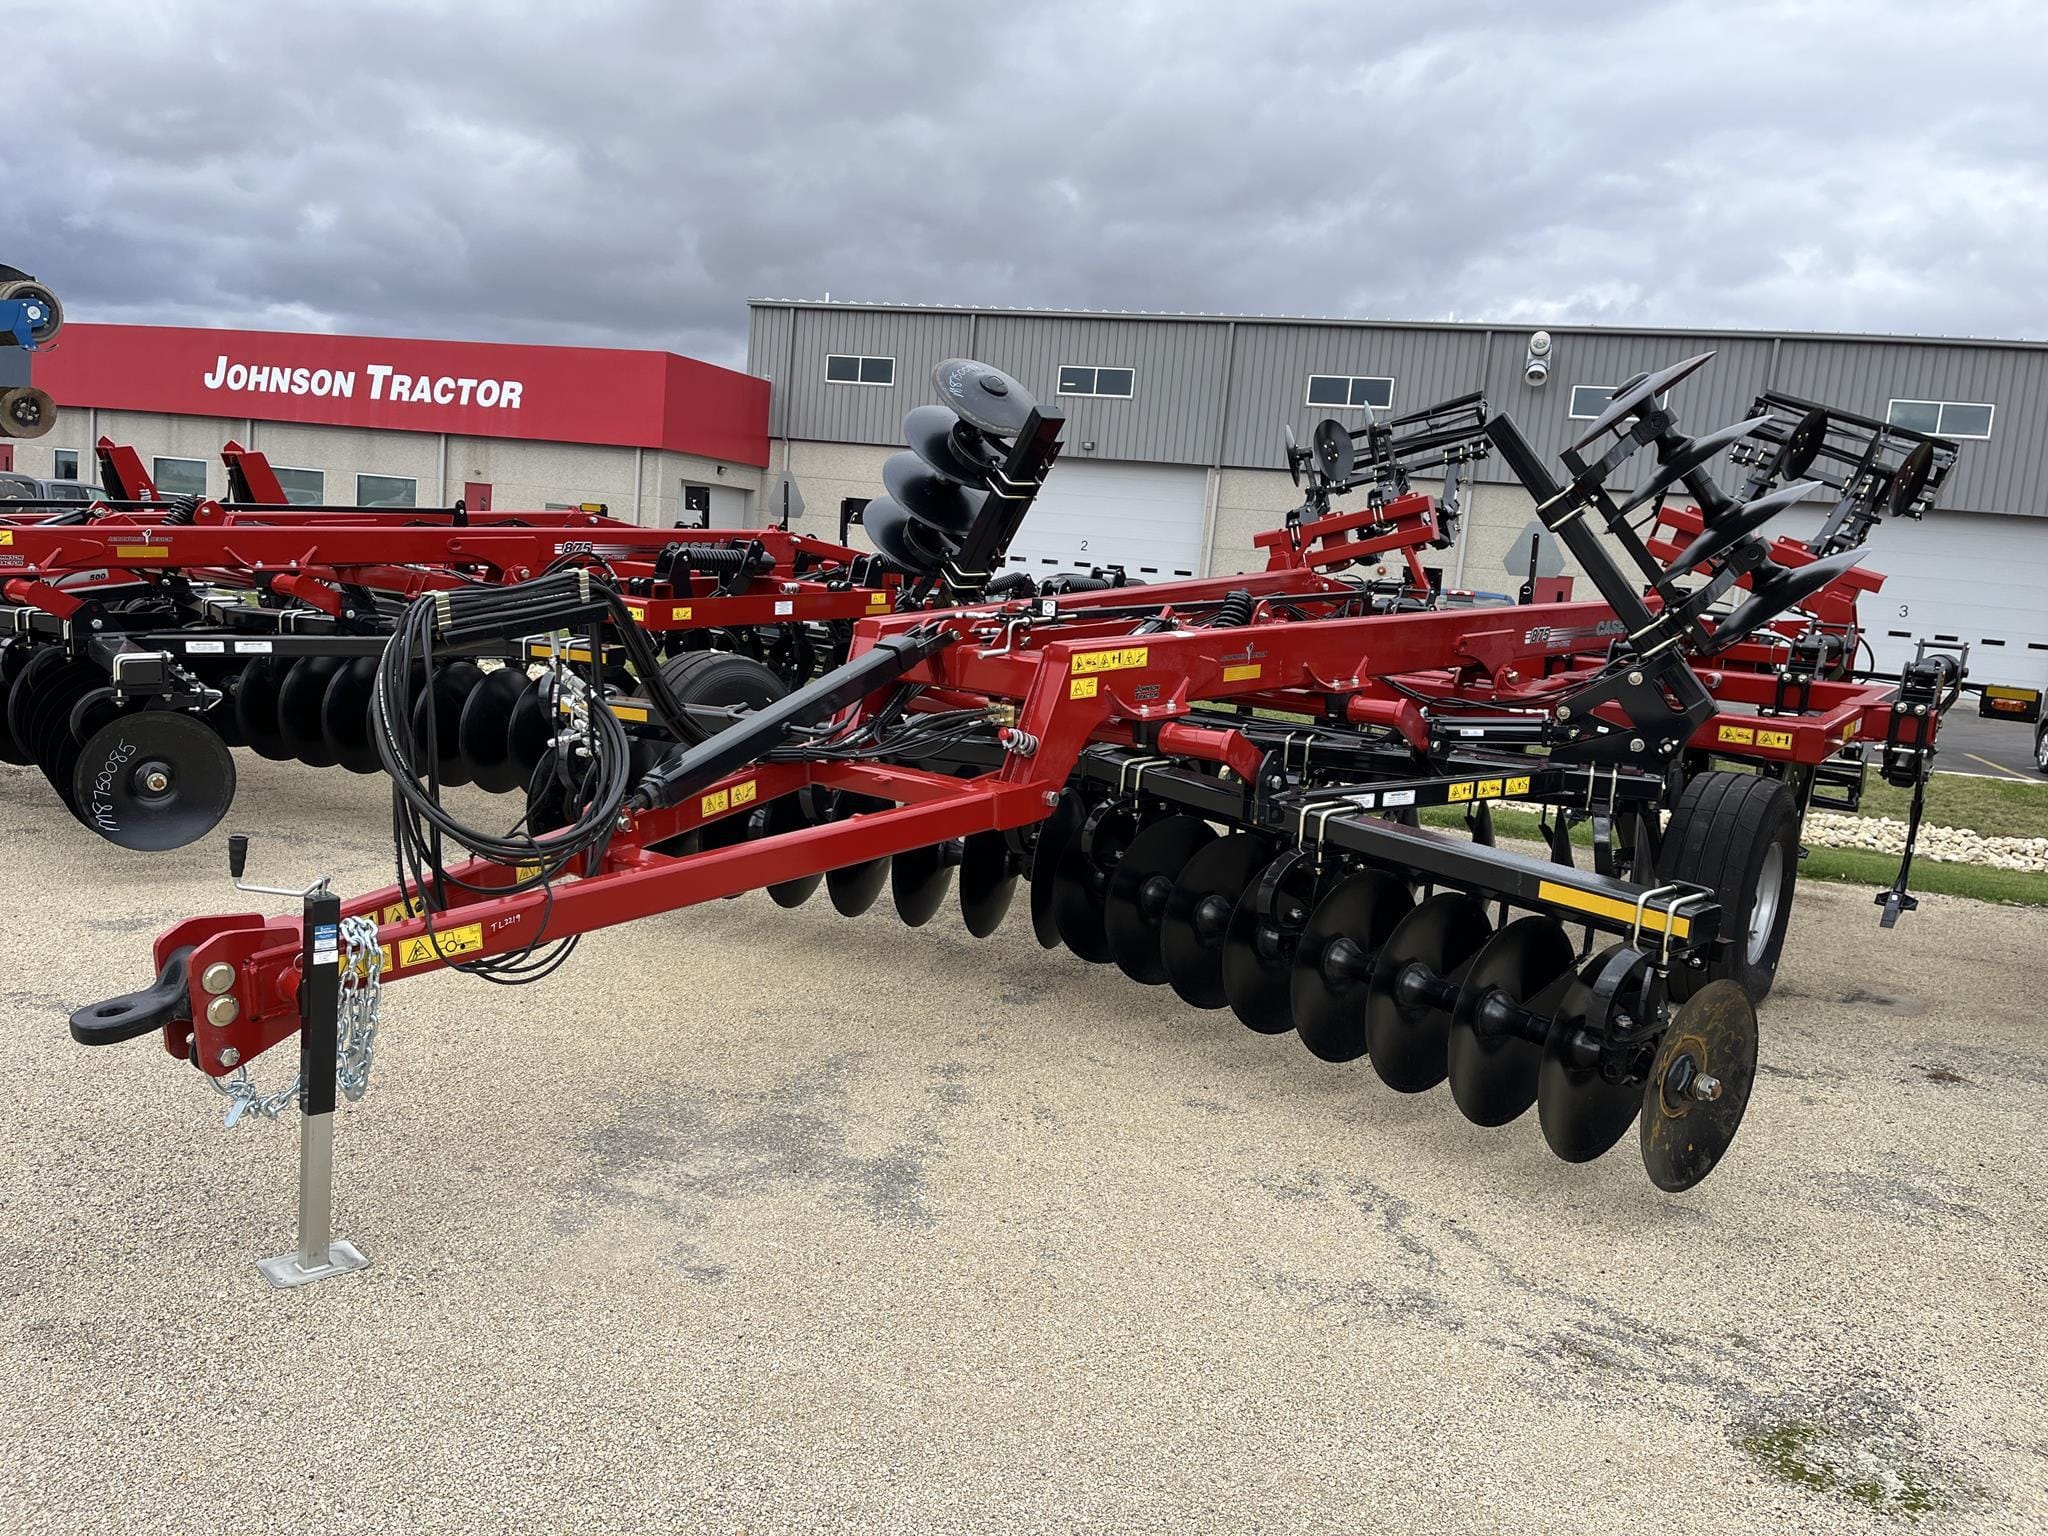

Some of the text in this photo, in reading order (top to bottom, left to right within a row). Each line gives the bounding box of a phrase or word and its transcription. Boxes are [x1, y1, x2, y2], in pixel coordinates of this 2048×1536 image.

[203, 355, 524, 409] JOHNSON TRACTOR
[562, 541, 593, 555] 875
[1080, 540, 1089, 551] 2
[89, 573, 106, 581] 500
[1898, 604, 1909, 618] 3
[1530, 626, 1551, 643] 875
[92, 738, 137, 832] M8750085
